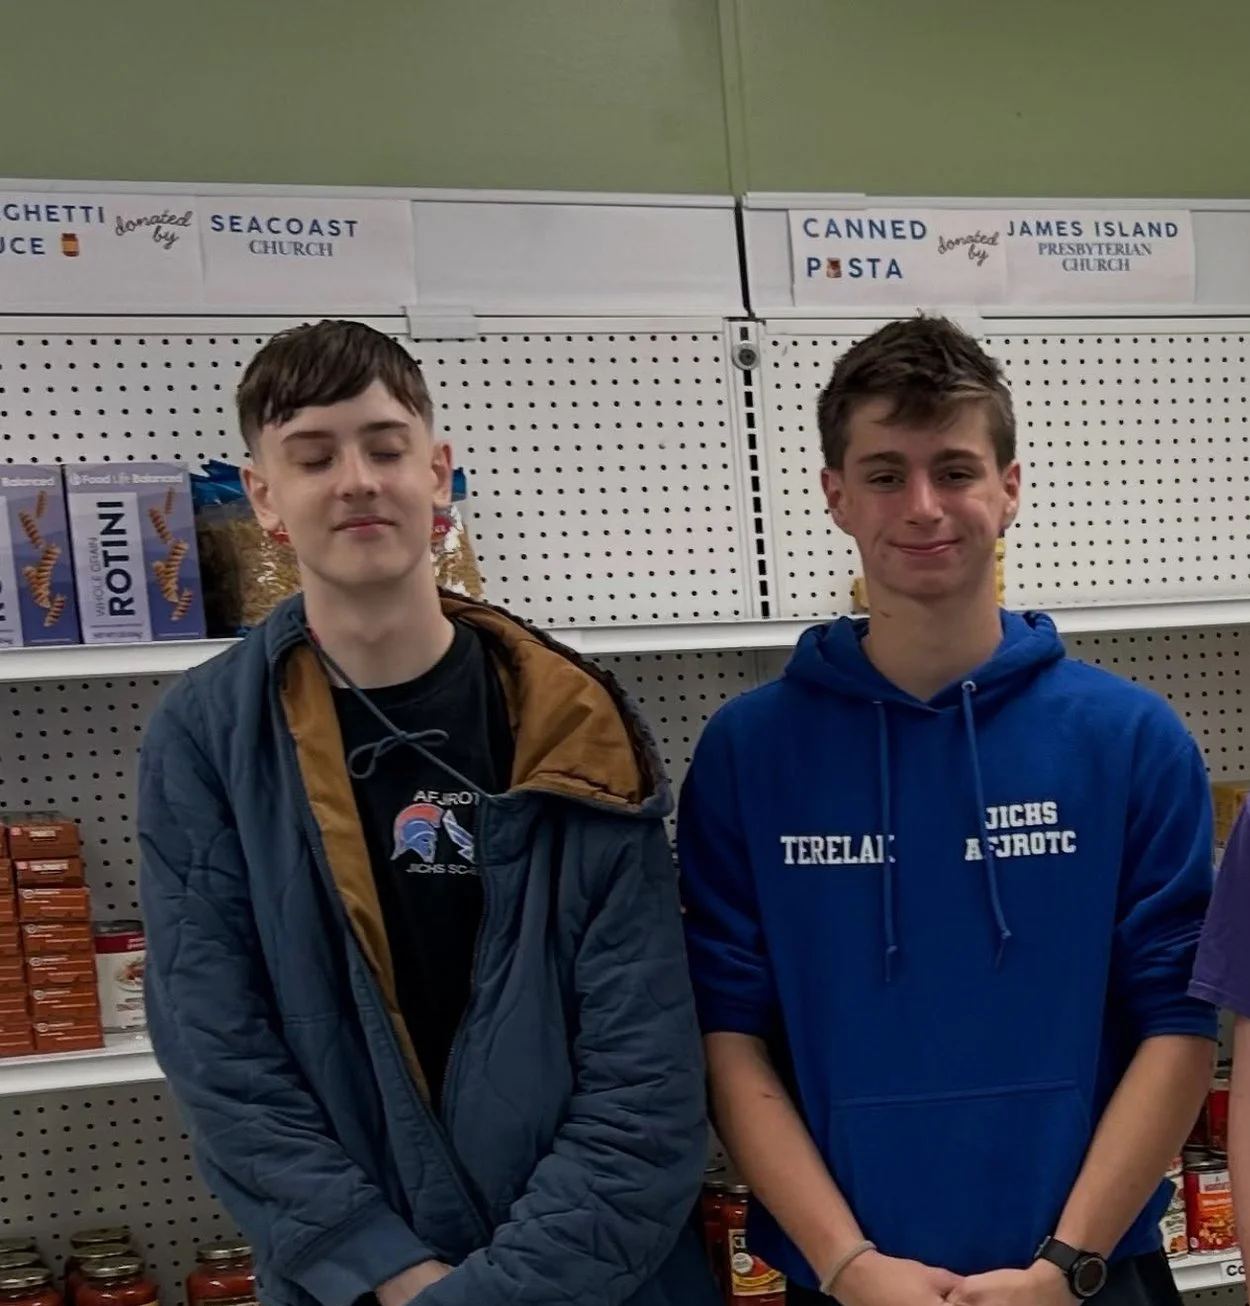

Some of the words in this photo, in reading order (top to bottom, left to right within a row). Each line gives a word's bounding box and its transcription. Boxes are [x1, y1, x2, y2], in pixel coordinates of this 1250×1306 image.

[0, 203, 105, 224] GHETTI
[115, 209, 193, 237] donated
[151, 226, 179, 249] by
[210, 214, 359, 238] SEACOAST
[803, 218, 928, 240] CANNED
[1006, 220, 1083, 238] JAMES
[1094, 221, 1178, 238] ISLAND
[248, 240, 334, 257] CHURCH
[938, 230, 999, 255] donated
[1038, 242, 1153, 256] PRESBYTERIAN
[968, 243, 989, 266] by
[1062, 258, 1131, 272] CHURCH
[806, 256, 903, 279] PSTA
[87, 536, 101, 574] GRAIN
[97, 501, 136, 617] ROTINI
[90, 575, 105, 618] WHOLE
[986, 801, 1059, 830] JICHS
